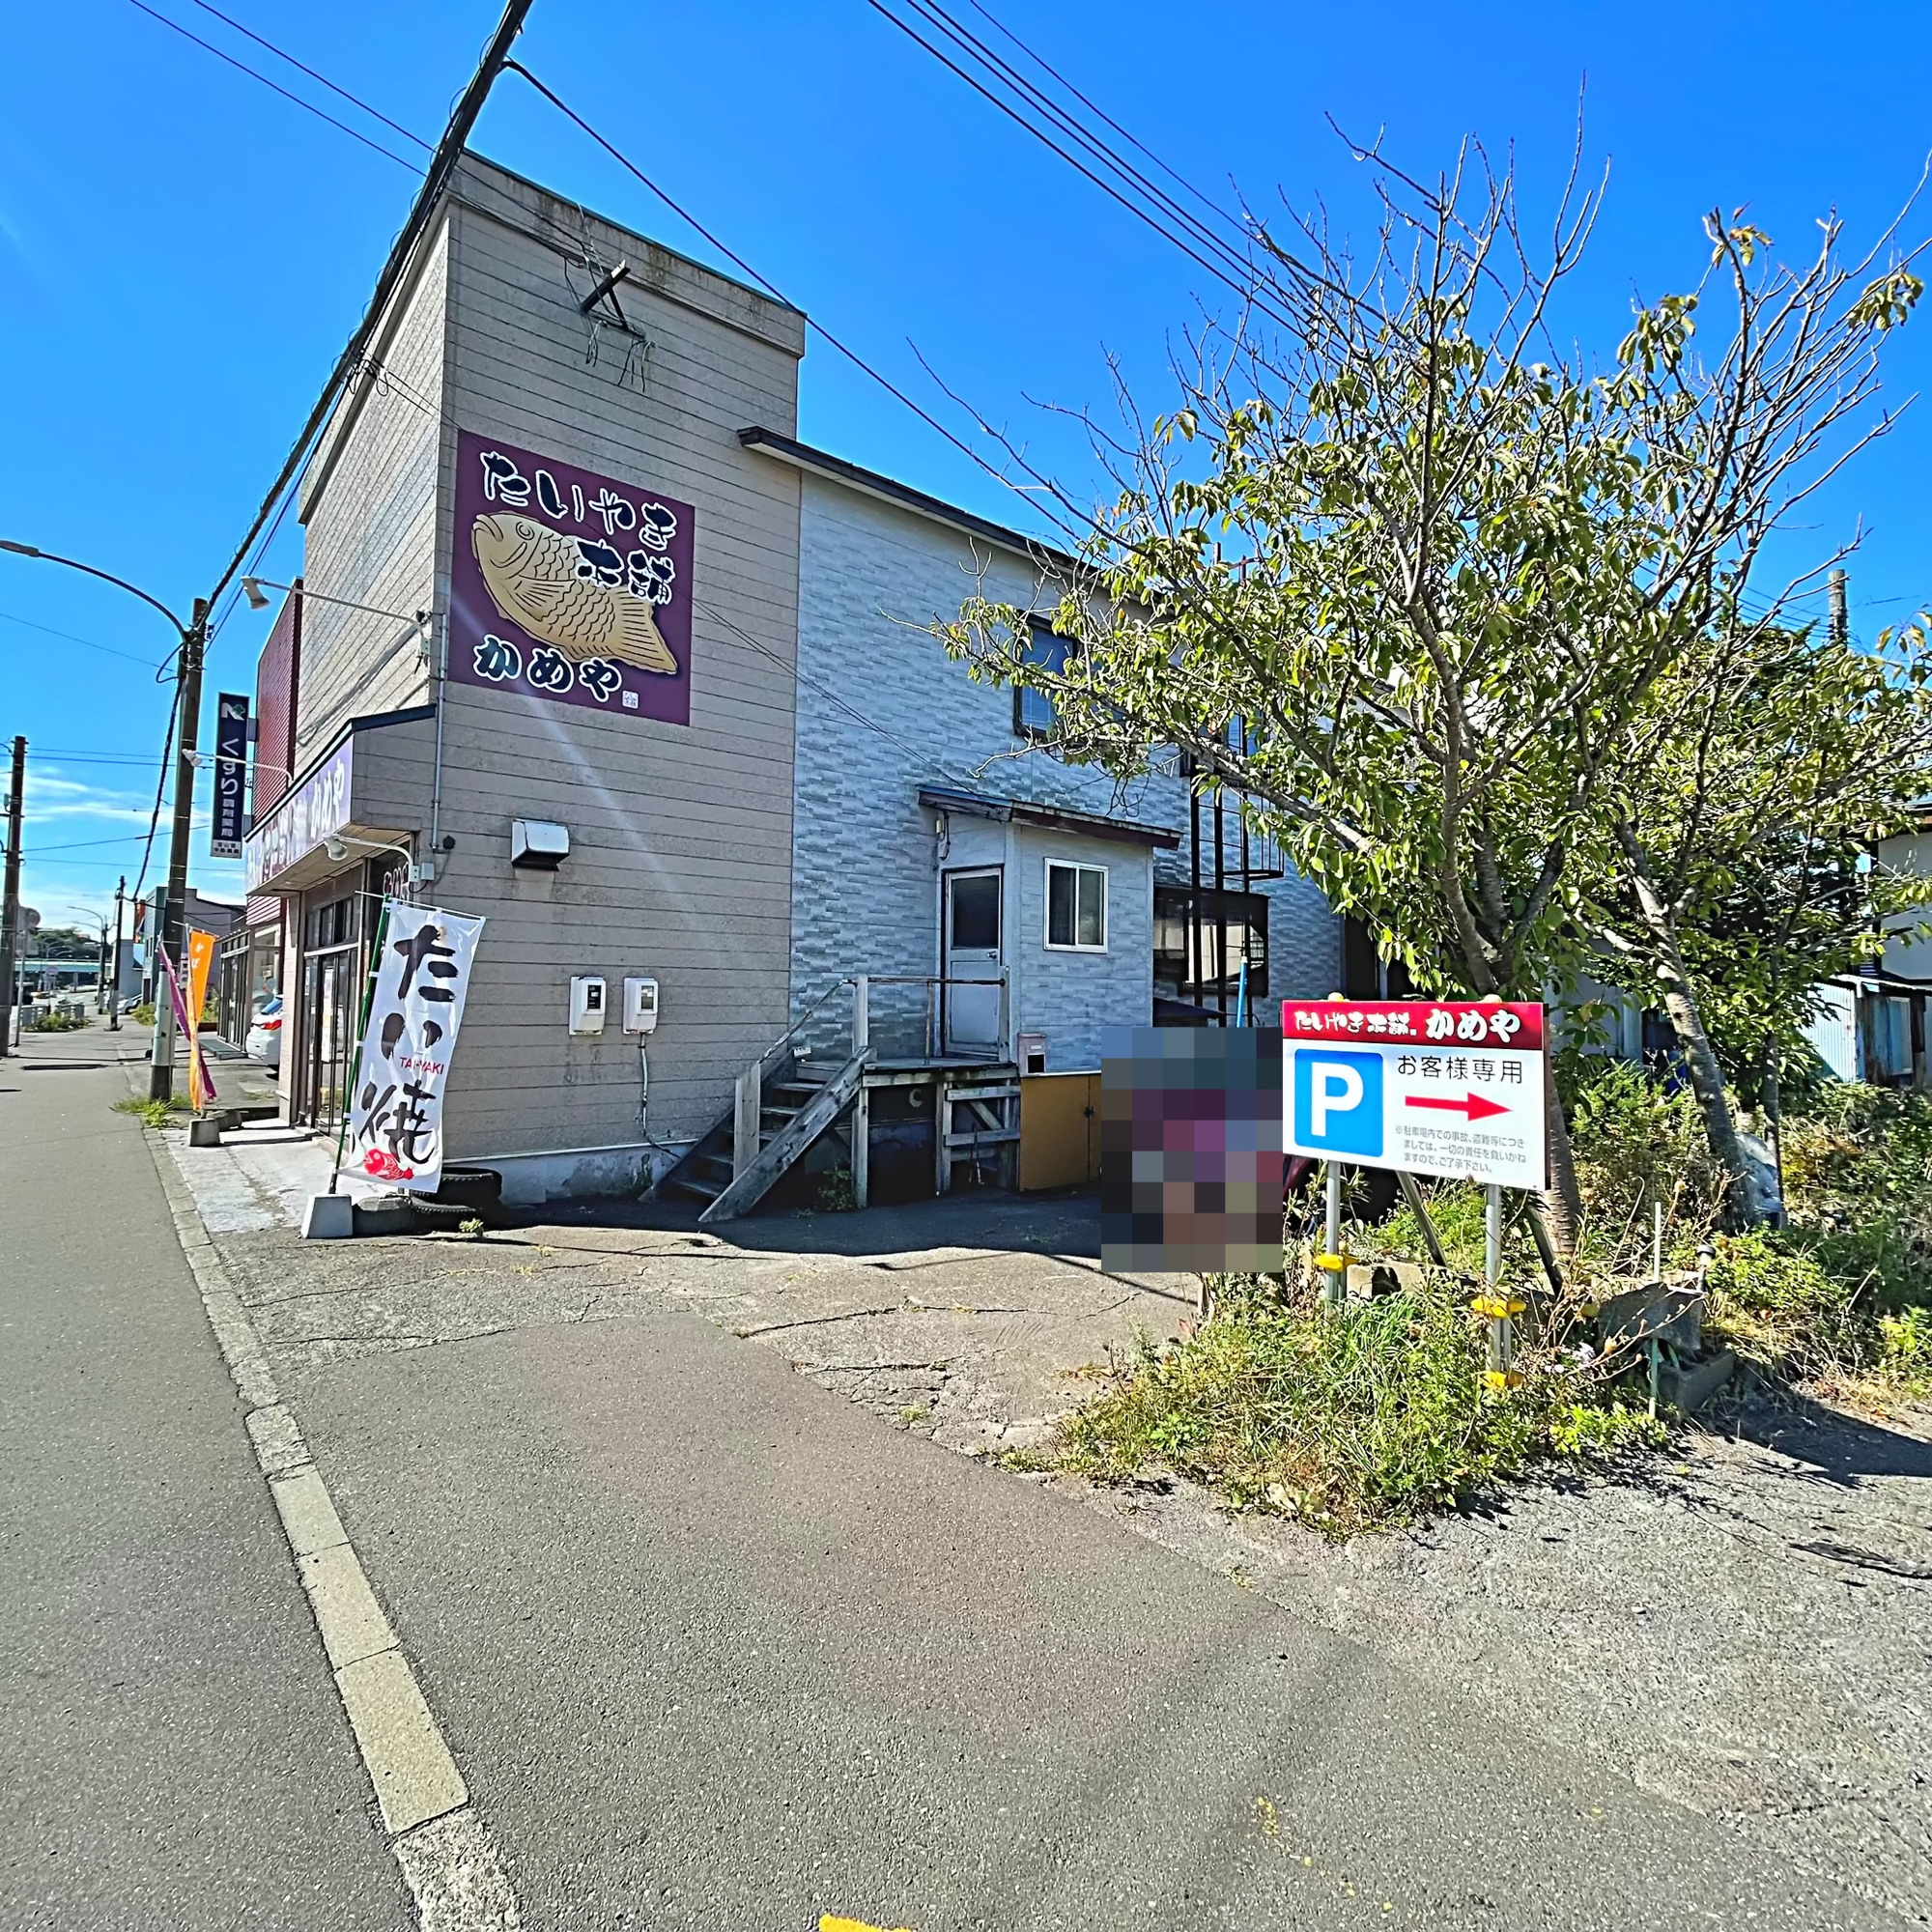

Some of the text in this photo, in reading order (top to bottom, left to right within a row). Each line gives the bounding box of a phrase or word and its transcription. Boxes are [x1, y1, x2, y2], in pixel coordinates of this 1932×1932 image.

[479, 451, 677, 551] たいやき
[473, 634, 623, 702] かめや
[1426, 1009, 1521, 1042] かめや
[399, 1056, 445, 1075] TAI-YAKI
[1397, 1055, 1523, 1084] お客様専用
[1311, 1062, 1364, 1137] P
